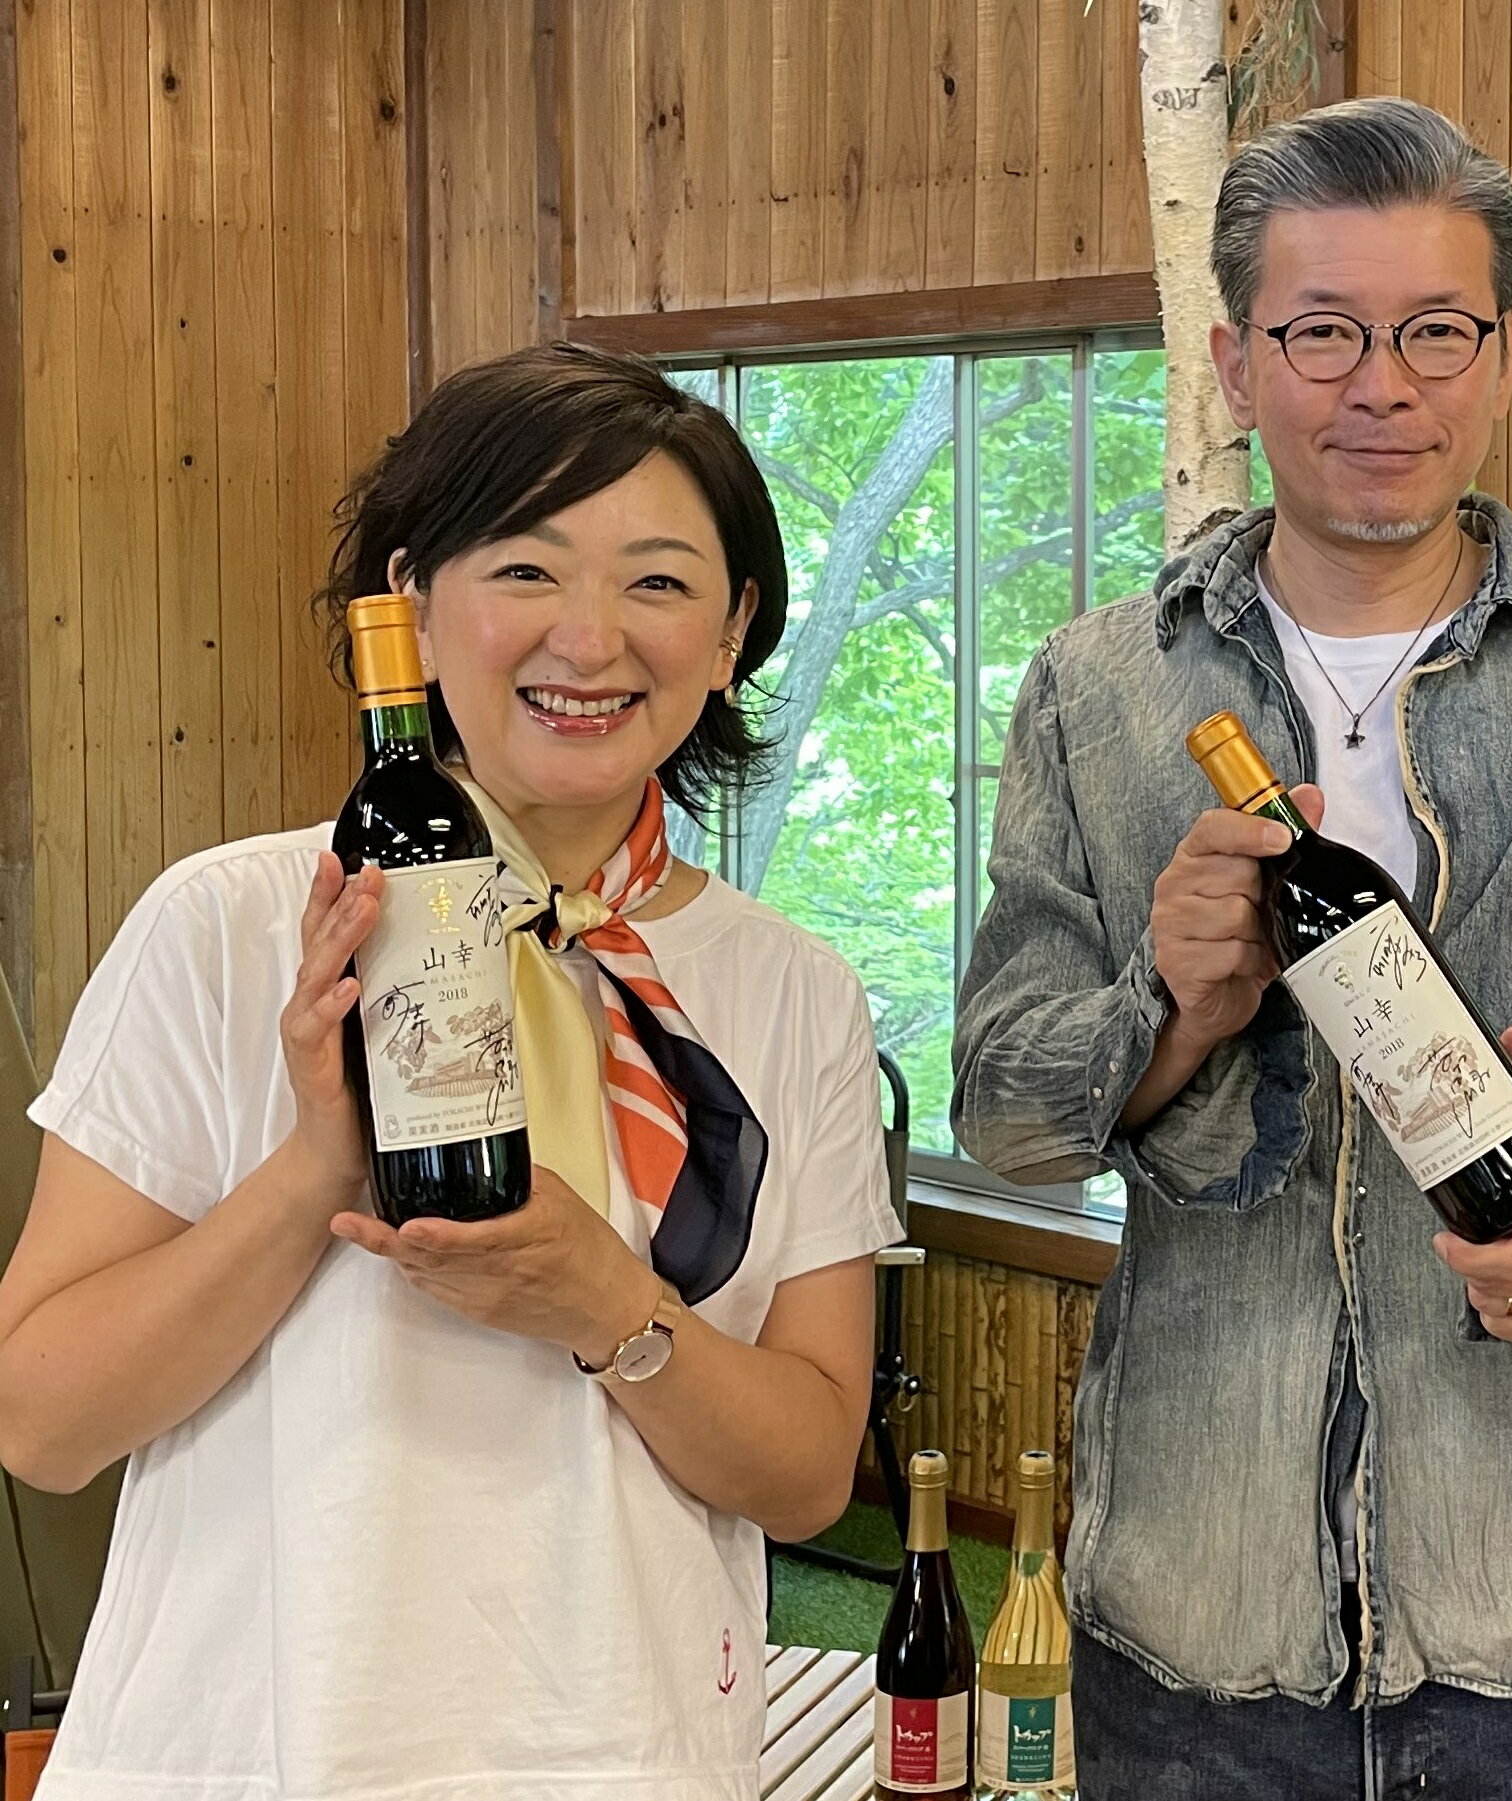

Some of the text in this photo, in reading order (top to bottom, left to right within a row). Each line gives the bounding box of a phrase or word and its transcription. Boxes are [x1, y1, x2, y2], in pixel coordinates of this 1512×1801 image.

[423, 939, 474, 972] 山幸
[438, 986, 469, 1003] 2018
[1353, 998, 1393, 1038] 山幸
[1378, 1037, 1405, 1060] 2018
